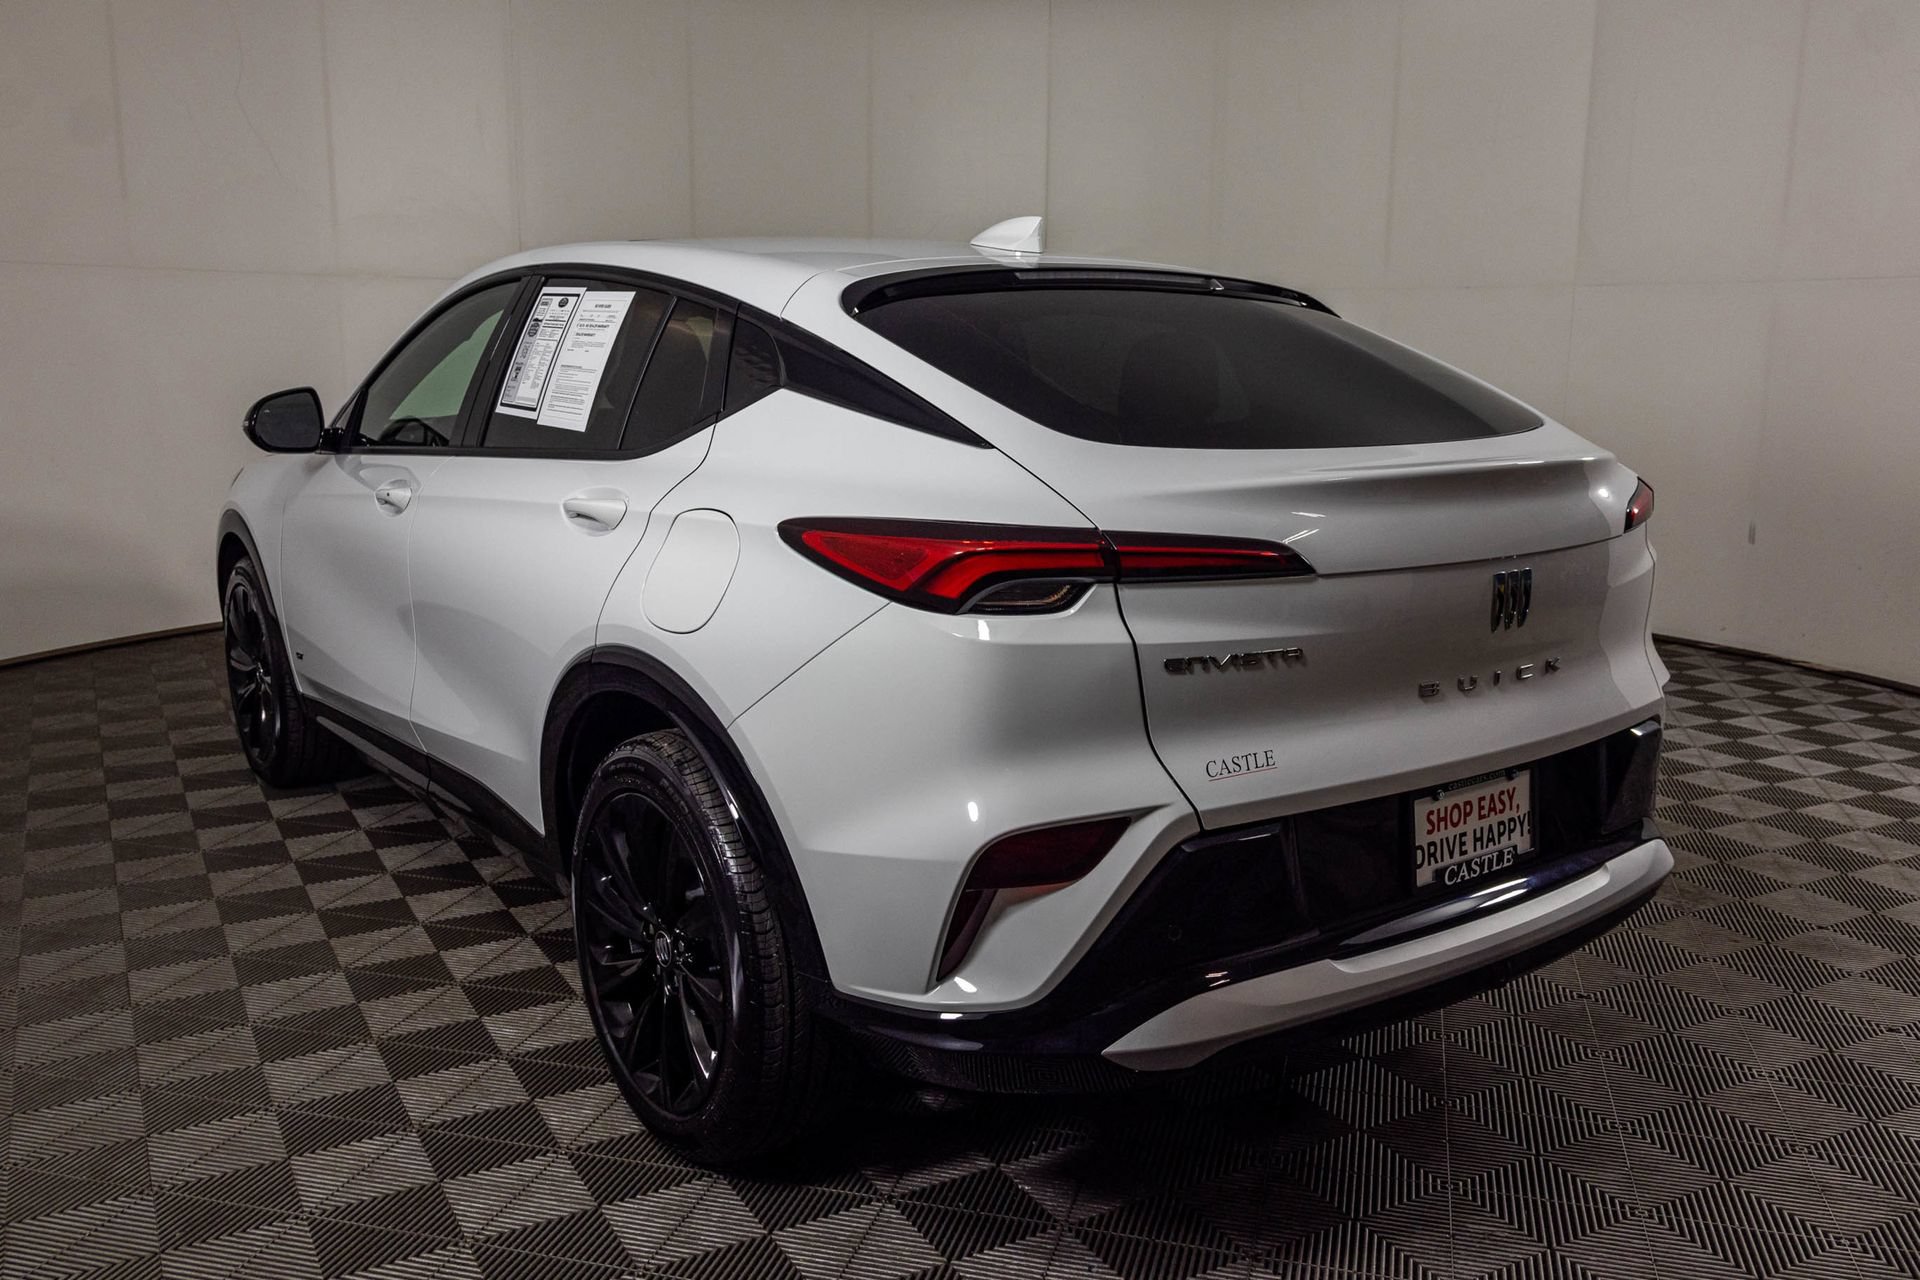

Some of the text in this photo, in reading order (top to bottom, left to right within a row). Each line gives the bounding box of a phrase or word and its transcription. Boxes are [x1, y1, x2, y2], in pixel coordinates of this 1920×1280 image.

[1418, 657, 1560, 699] BUICK
[1205, 750, 1276, 778] CASTLE
[1426, 787, 1520, 835] SHOP EASY,
[1416, 810, 1532, 869] DRIVE HAPPY!
[1444, 847, 1515, 886] CASTLE
